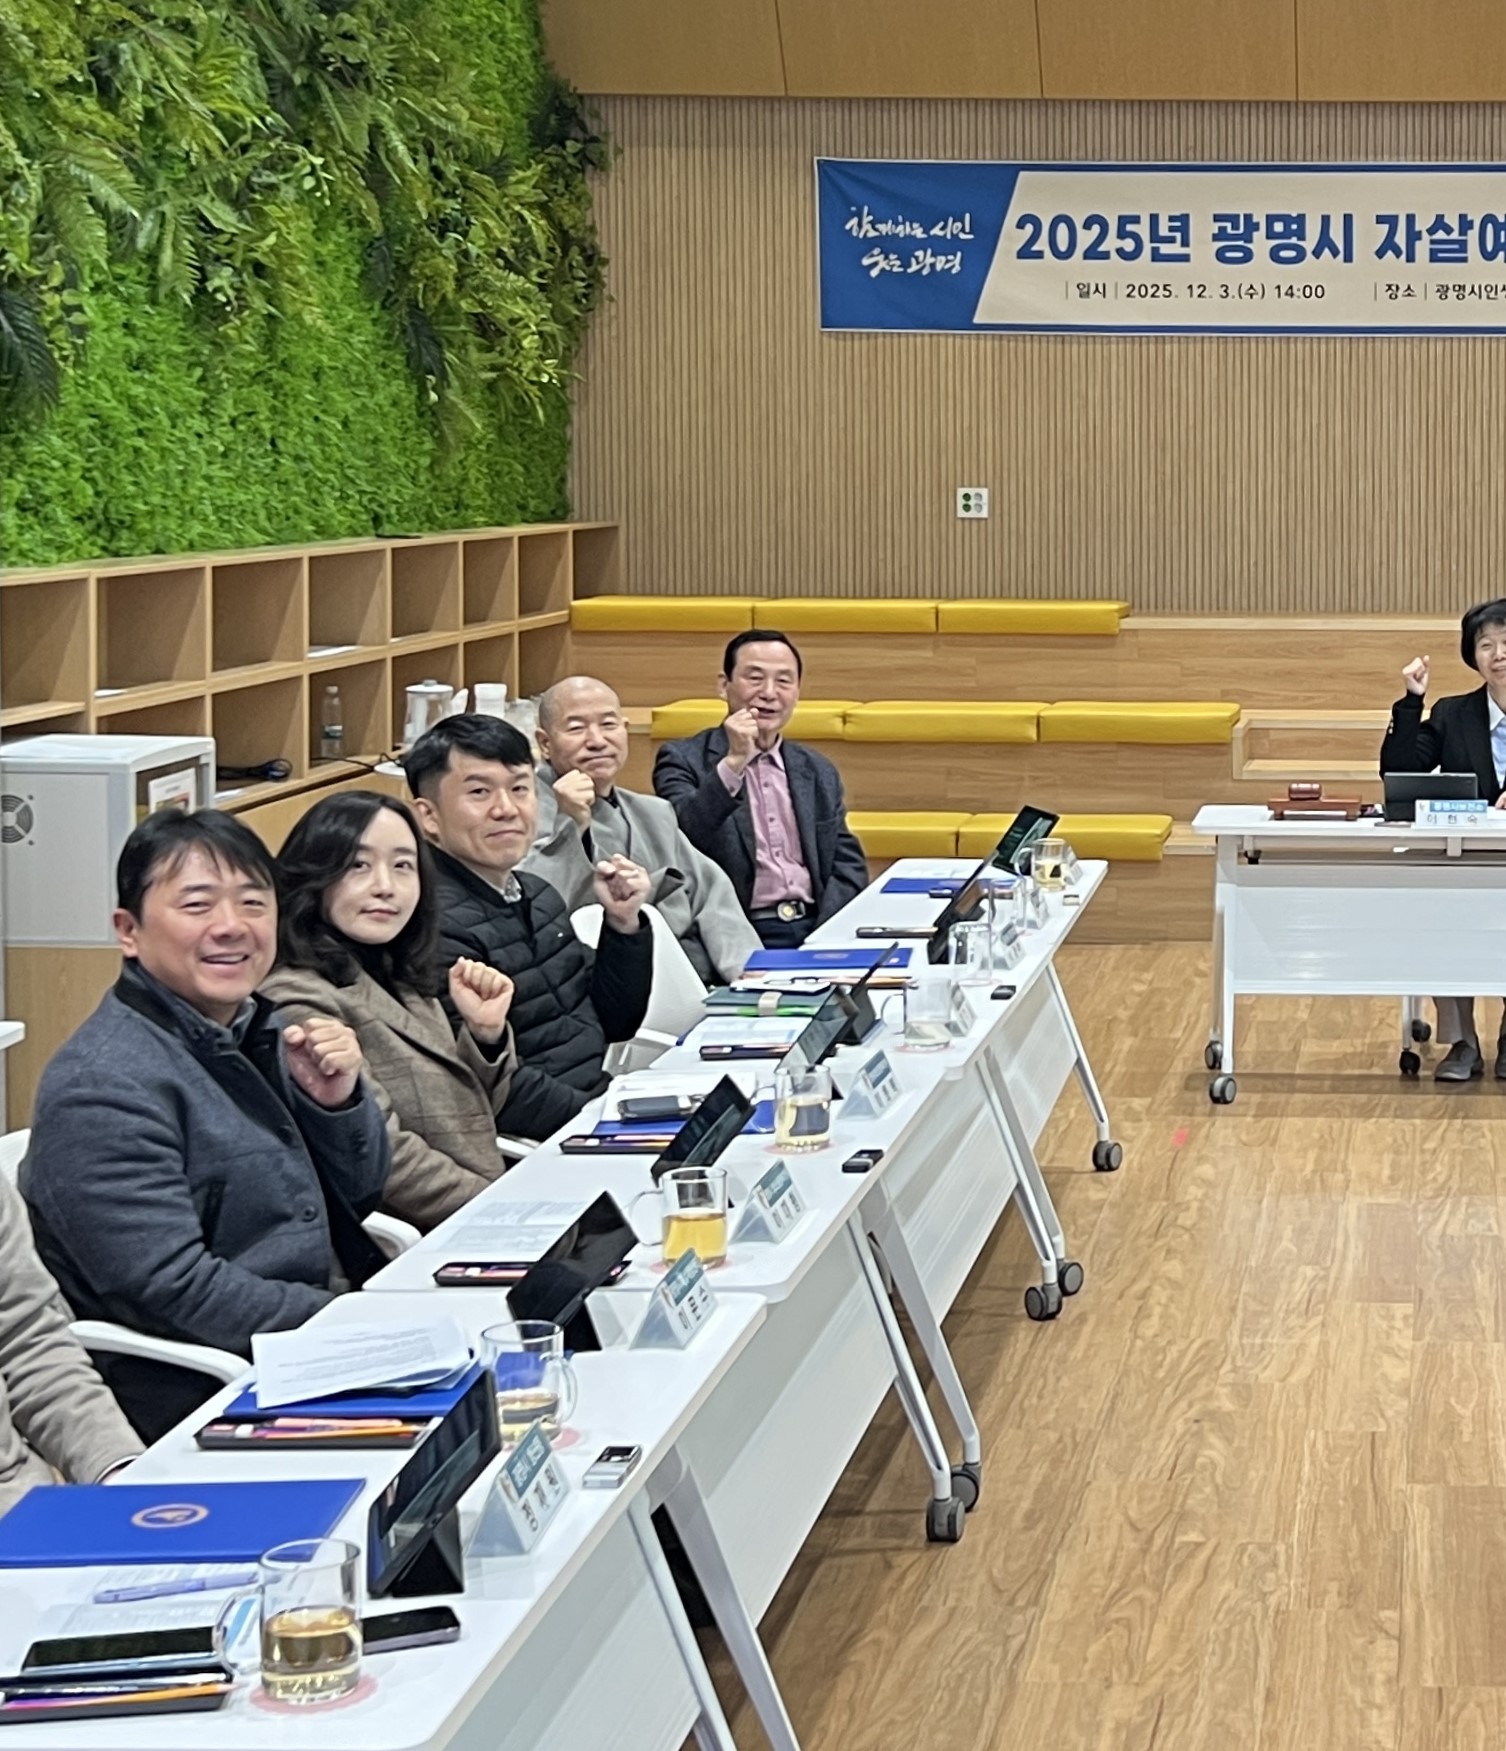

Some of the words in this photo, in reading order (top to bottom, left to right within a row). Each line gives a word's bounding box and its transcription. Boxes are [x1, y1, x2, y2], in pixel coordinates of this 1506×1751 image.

[929, 212, 975, 240] 시민
[1014, 212, 1192, 264] 2025년
[1211, 212, 1354, 266] 광명시
[906, 247, 962, 276] 광명
[1076, 282, 1107, 300] 일시
[1125, 283, 1180, 299] 2025.
[1186, 283, 1214, 299] 12.
[1218, 282, 1266, 300] 3.(수)
[1274, 283, 1326, 299] 14:00
[1384, 283, 1417, 301] 장소
